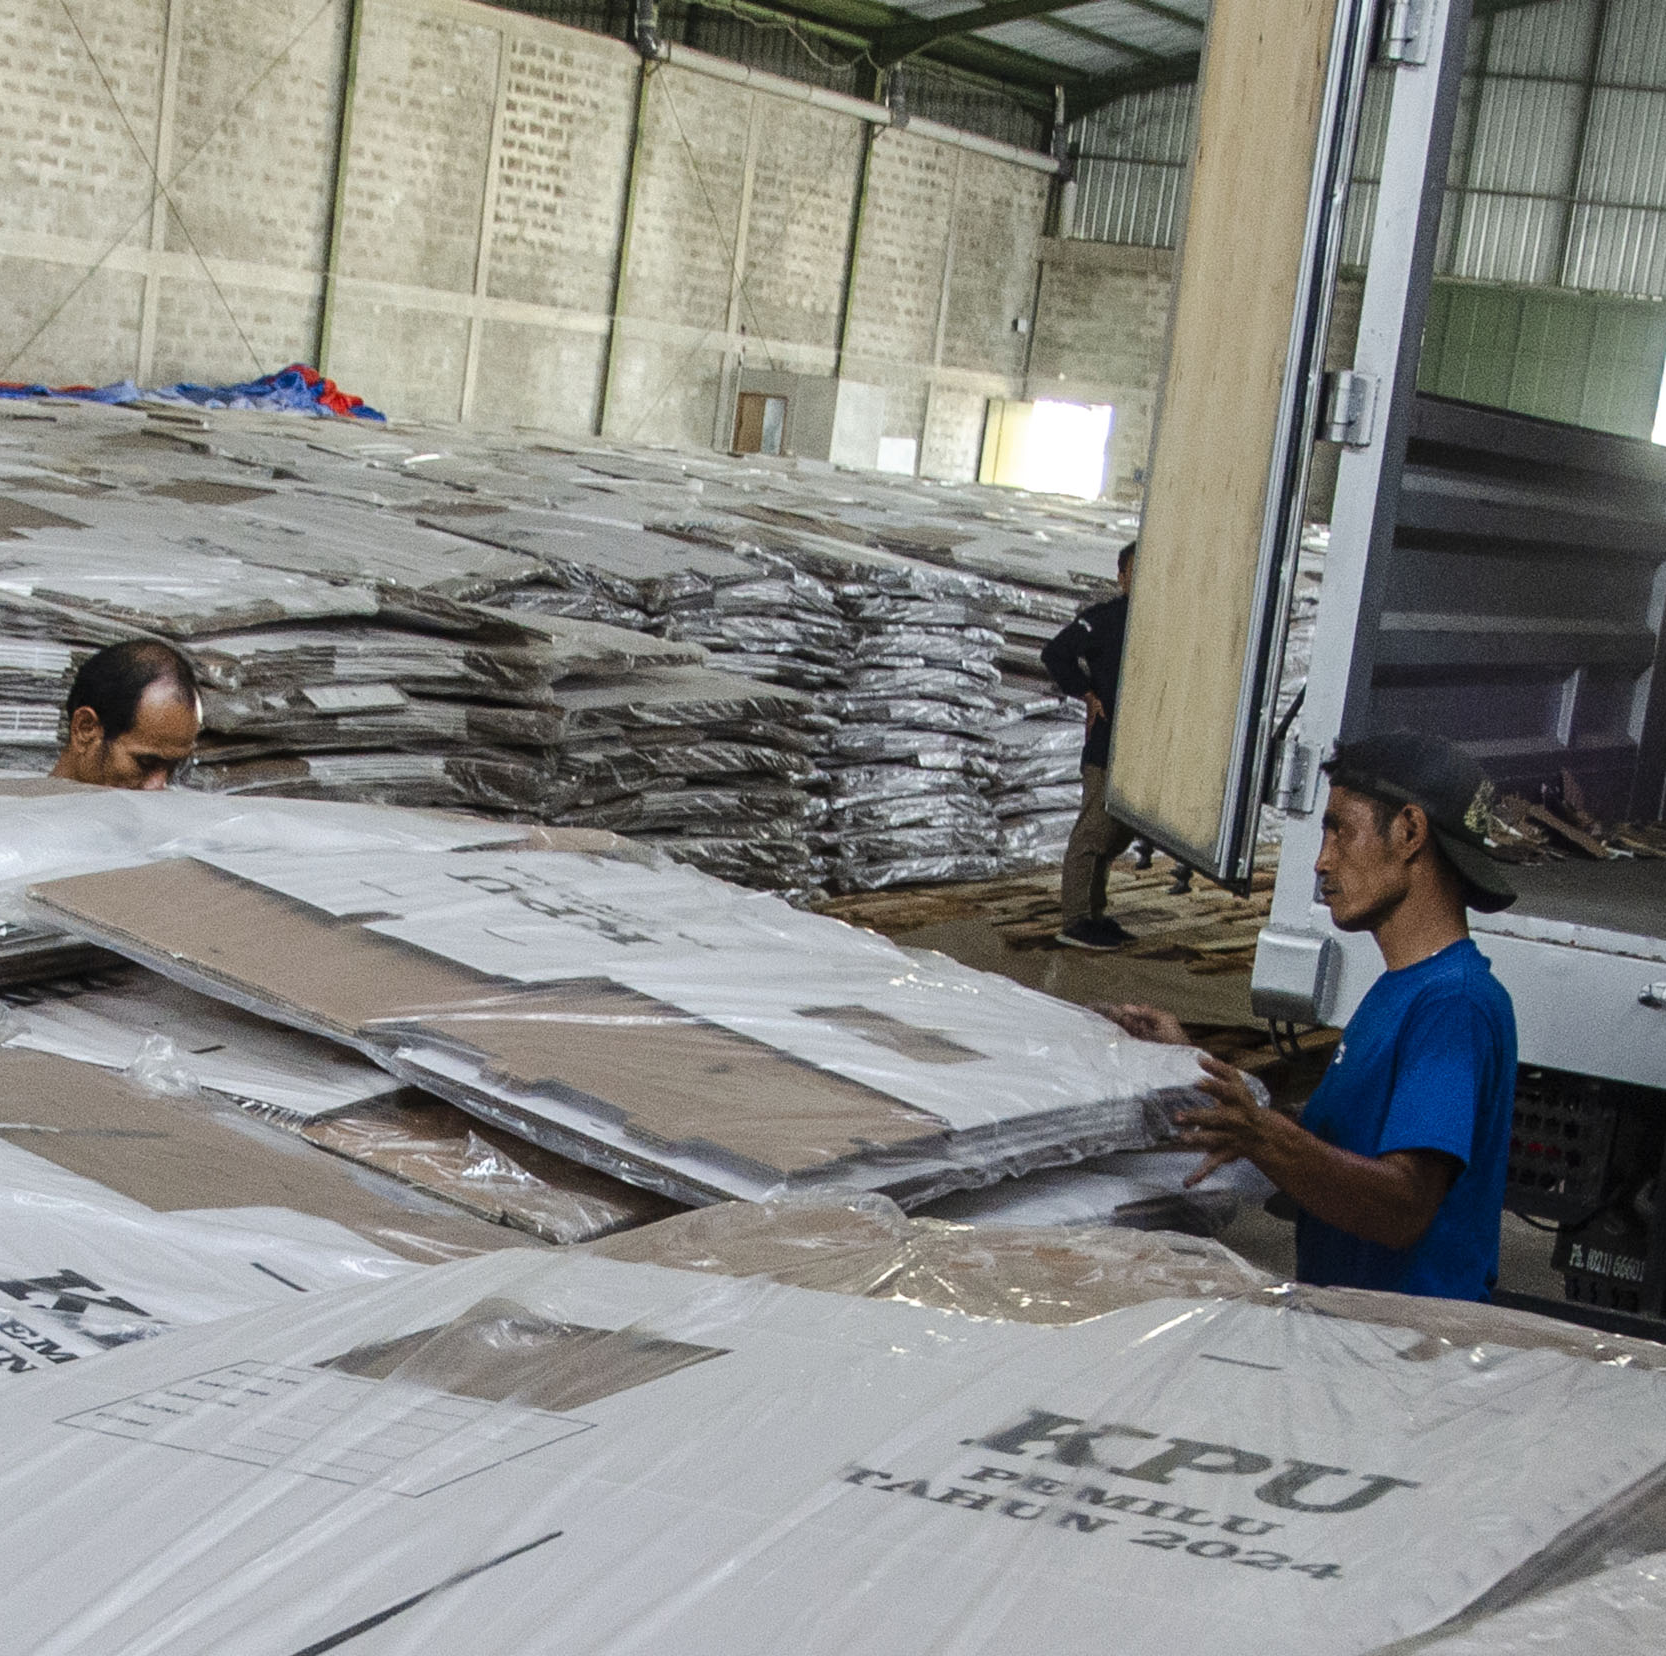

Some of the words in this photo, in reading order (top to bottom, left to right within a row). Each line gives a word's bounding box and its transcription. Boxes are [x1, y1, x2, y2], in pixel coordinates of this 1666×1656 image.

[959, 1408, 1421, 1514] KPU
[961, 1465, 1285, 1537] PEMILU
[844, 1467, 1117, 1533] TAHUN
[1128, 1530, 1343, 1580] 2024
